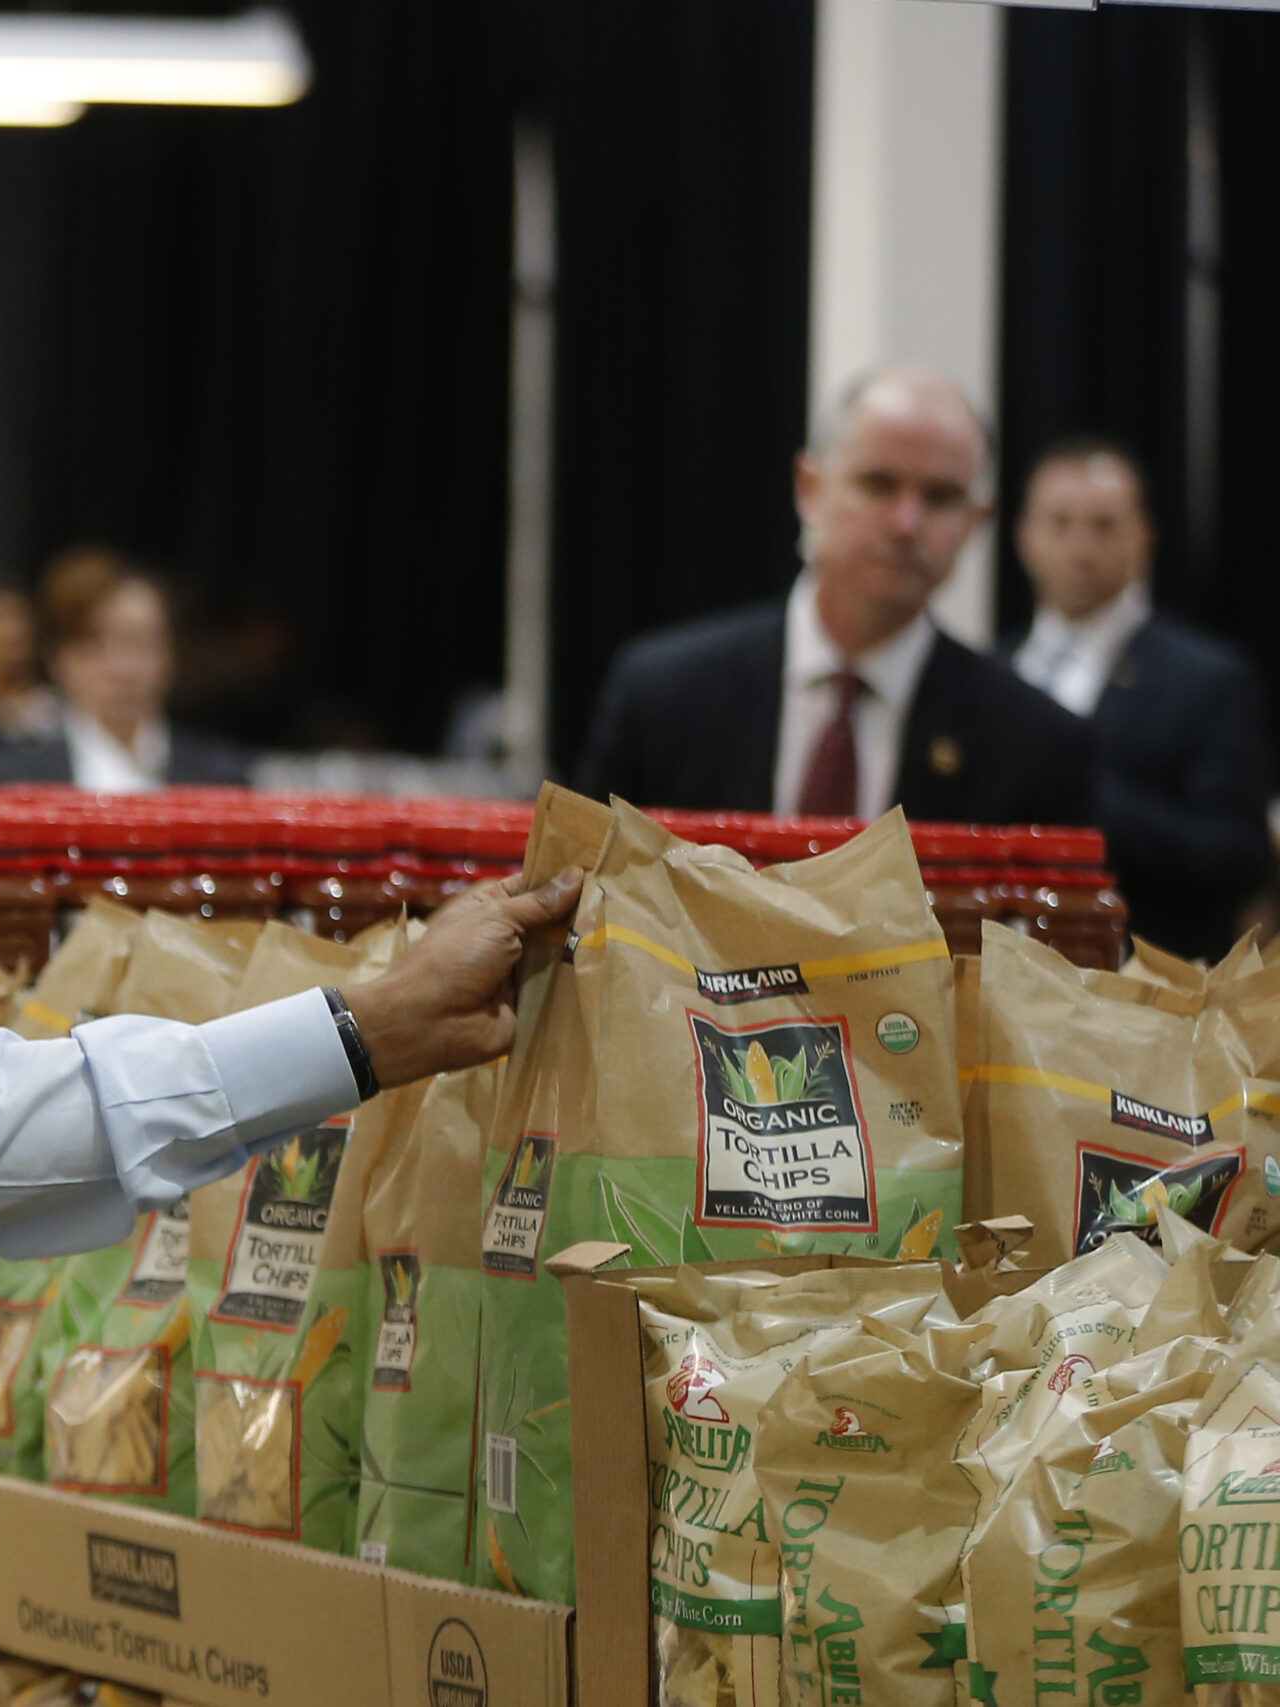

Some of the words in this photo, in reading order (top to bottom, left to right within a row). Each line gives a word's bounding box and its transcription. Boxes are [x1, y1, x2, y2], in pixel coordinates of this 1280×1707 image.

[698, 969, 798, 993] KIRKLAND
[846, 972, 868, 983] ITEM
[723, 1099, 839, 1131] ORGANIC
[1116, 1094, 1207, 1136] KIRKLAND
[716, 1126, 853, 1166] TORTILLA
[743, 1160, 831, 1190] CHIPS
[714, 1204, 769, 1217] YELLOW
[779, 1209, 822, 1223] WHITE
[825, 1210, 860, 1221] CORN
[753, 1195, 762, 1206] A
[806, 1199, 824, 1209] OF
[248, 1236, 316, 1266] TORTILL
[253, 1262, 309, 1291] CHIPS
[1077, 1319, 1094, 1334] in
[814, 1431, 893, 1453] ABUELITA
[92, 1541, 176, 1592] KIRKLAND
[651, 1524, 713, 1588] CHIPS
[703, 1605, 742, 1626] Corn
[1033, 1509, 1093, 1707] TORTIL
[1197, 1584, 1280, 1635] CHIP
[17, 1597, 104, 1653] ORGANIC
[109, 1621, 200, 1680] TORTILLA
[204, 1646, 269, 1697] CHIPS
[814, 1584, 864, 1706] ABUE
[441, 1649, 474, 1682] USDA
[1238, 1652, 1280, 1676] Whi
